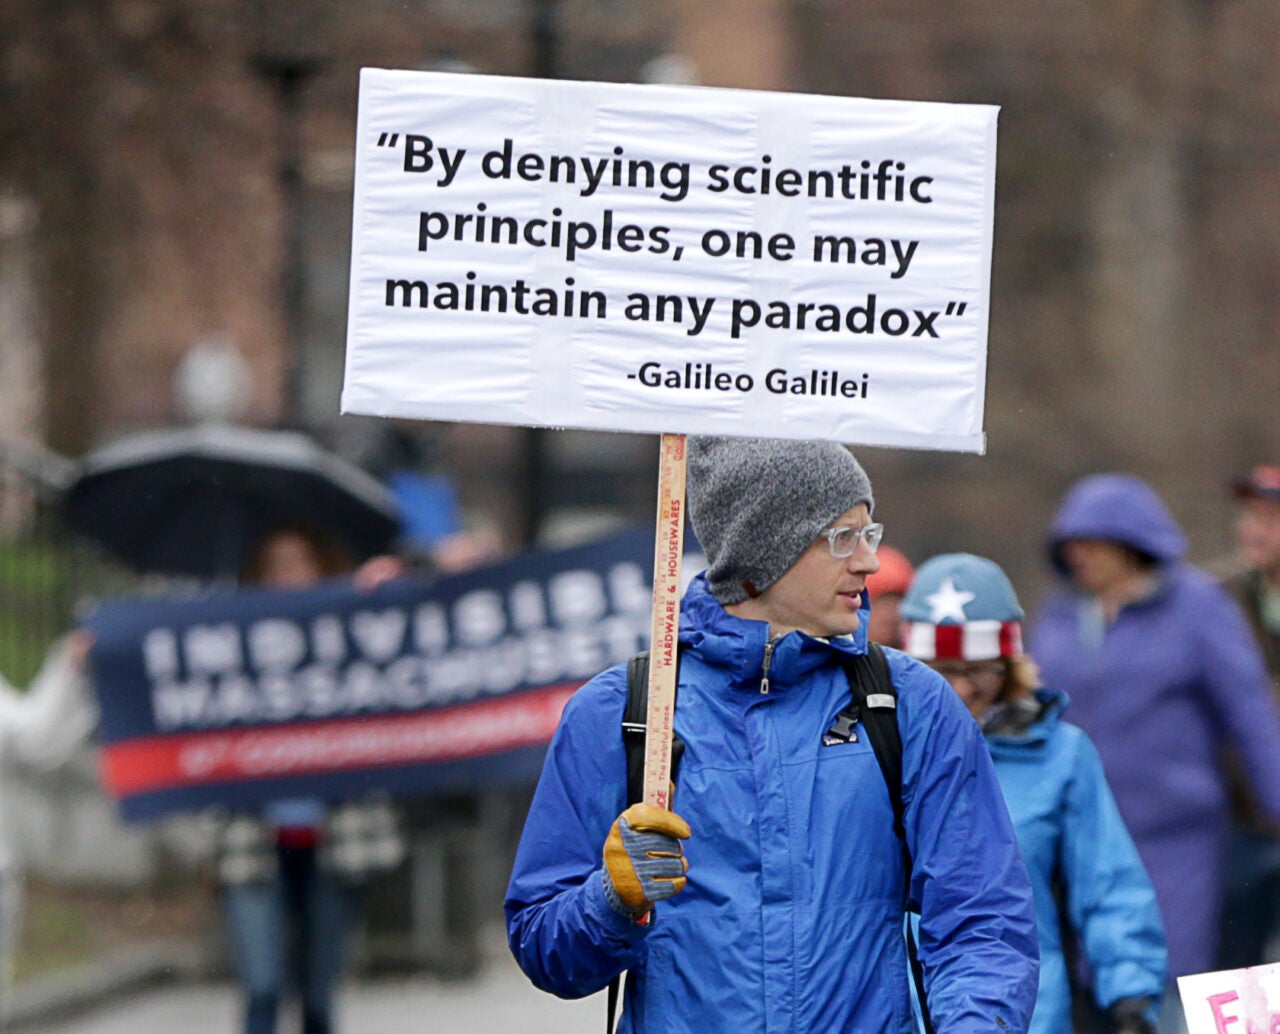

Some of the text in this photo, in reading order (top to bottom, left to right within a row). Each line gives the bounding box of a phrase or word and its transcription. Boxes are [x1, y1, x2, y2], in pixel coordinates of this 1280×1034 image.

[482, 139, 691, 201] denying
[707, 156, 935, 205] scientific
[418, 203, 919, 279] principles, one may
[384, 272, 967, 340] maintain any paradox”
[627, 362, 869, 400] -Galileo Galilei
[143, 555, 700, 678] INDIVISIBL
[663, 499, 681, 666] HARDWARE & HOUSEWARES
